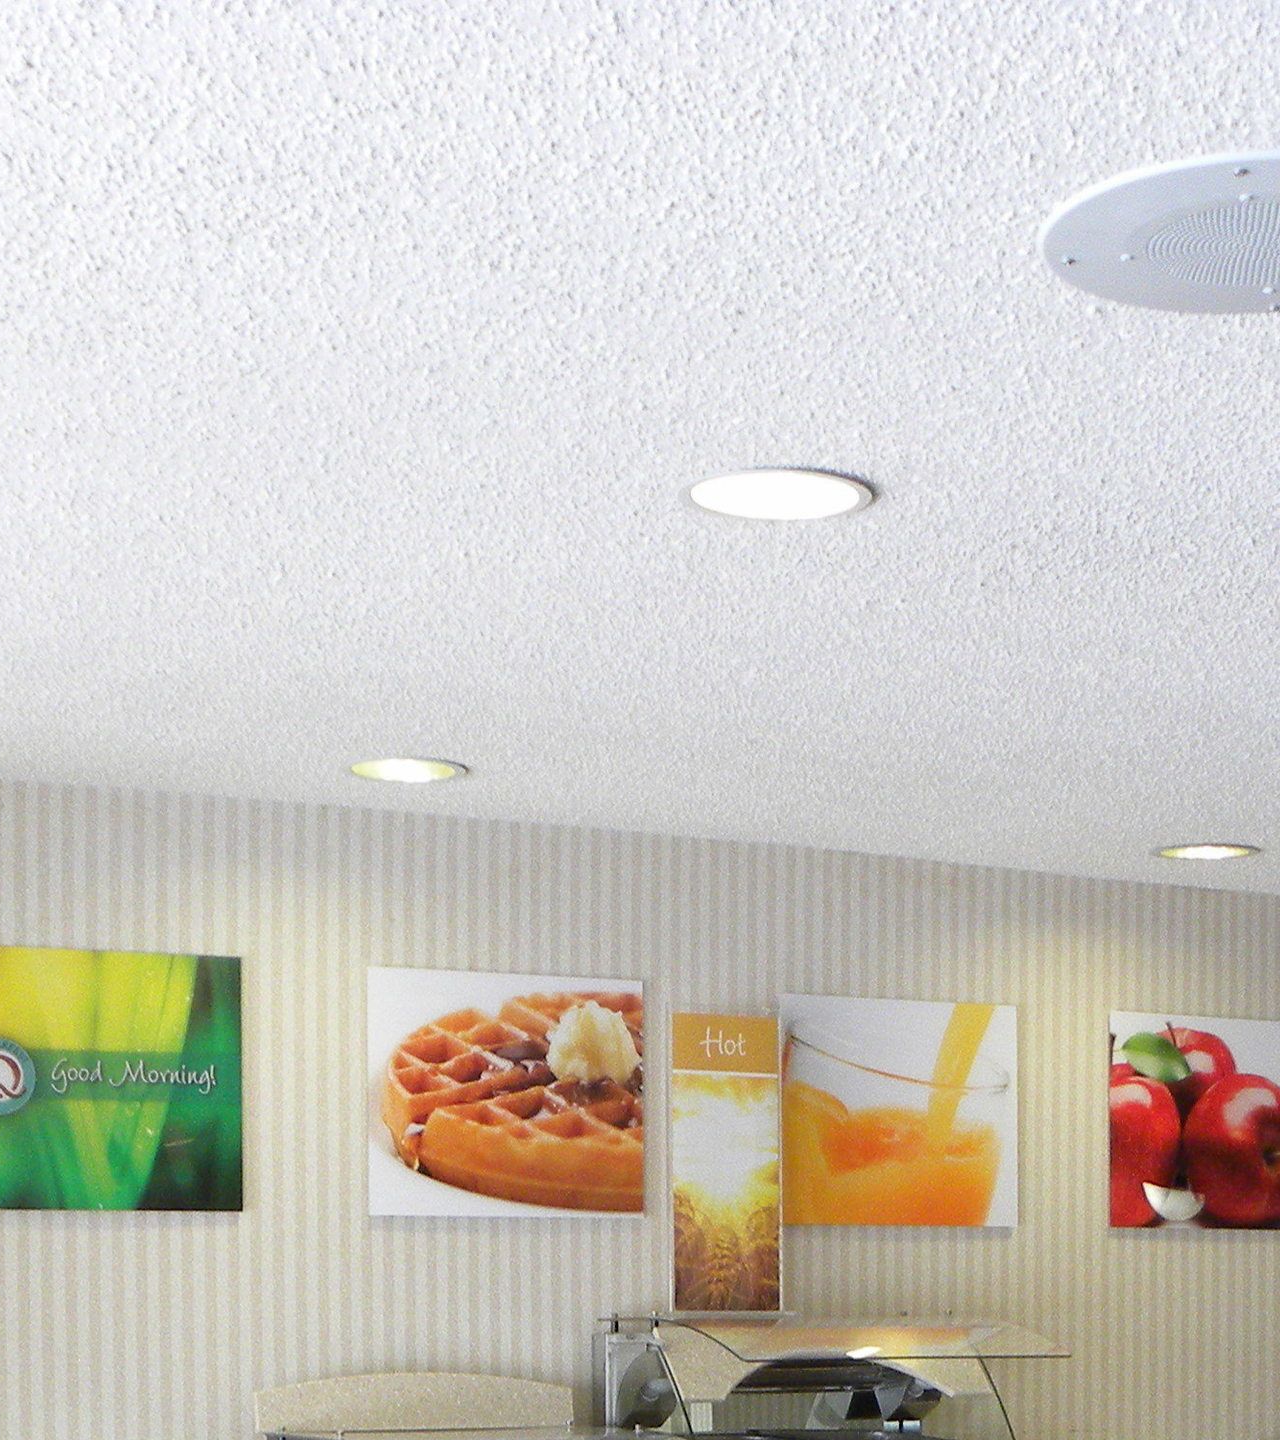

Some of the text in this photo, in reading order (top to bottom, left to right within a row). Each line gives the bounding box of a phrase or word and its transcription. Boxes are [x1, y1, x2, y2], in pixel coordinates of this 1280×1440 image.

[699, 1026, 747, 1058] Hot
[50, 1058, 217, 1095] Good Morning!
